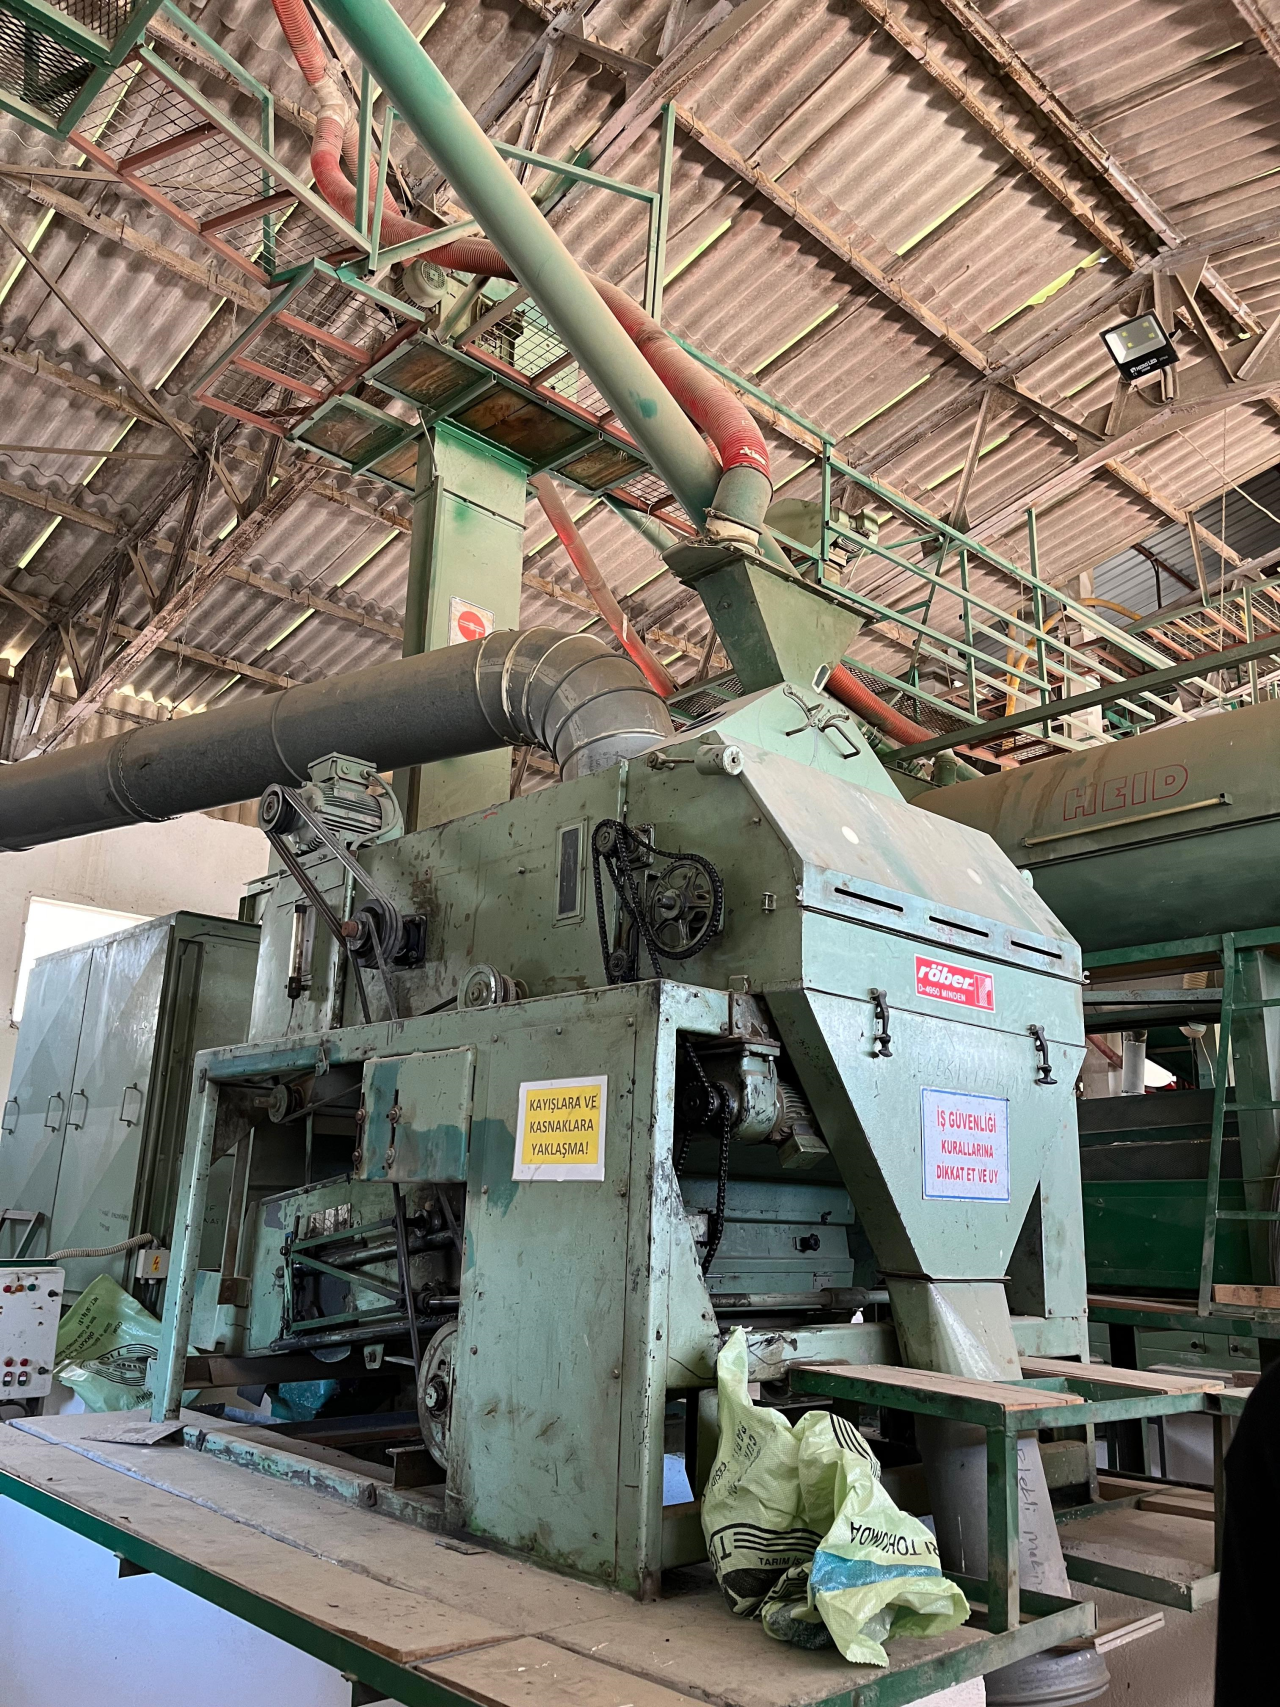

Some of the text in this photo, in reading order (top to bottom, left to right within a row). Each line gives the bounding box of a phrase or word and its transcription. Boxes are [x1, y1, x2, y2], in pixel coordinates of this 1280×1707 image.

[1063, 764, 1189, 822] HEID
[917, 963, 975, 991] röber
[917, 983, 966, 1002] D-4950 MINDEN
[529, 1095, 597, 1113] KAYIŞLARA VE
[529, 1118, 594, 1134] KASNAKLARA
[936, 1105, 997, 1133] İŞ GÜVENLİĞİ
[531, 1141, 589, 1158] YAKLAŞMA!
[941, 1139, 994, 1158] KURALLARINA
[936, 1161, 999, 1184] DİKKAT ET VE UY
[850, 1521, 922, 1556] TOHUMDA
[758, 1556, 790, 1566] TARIM
